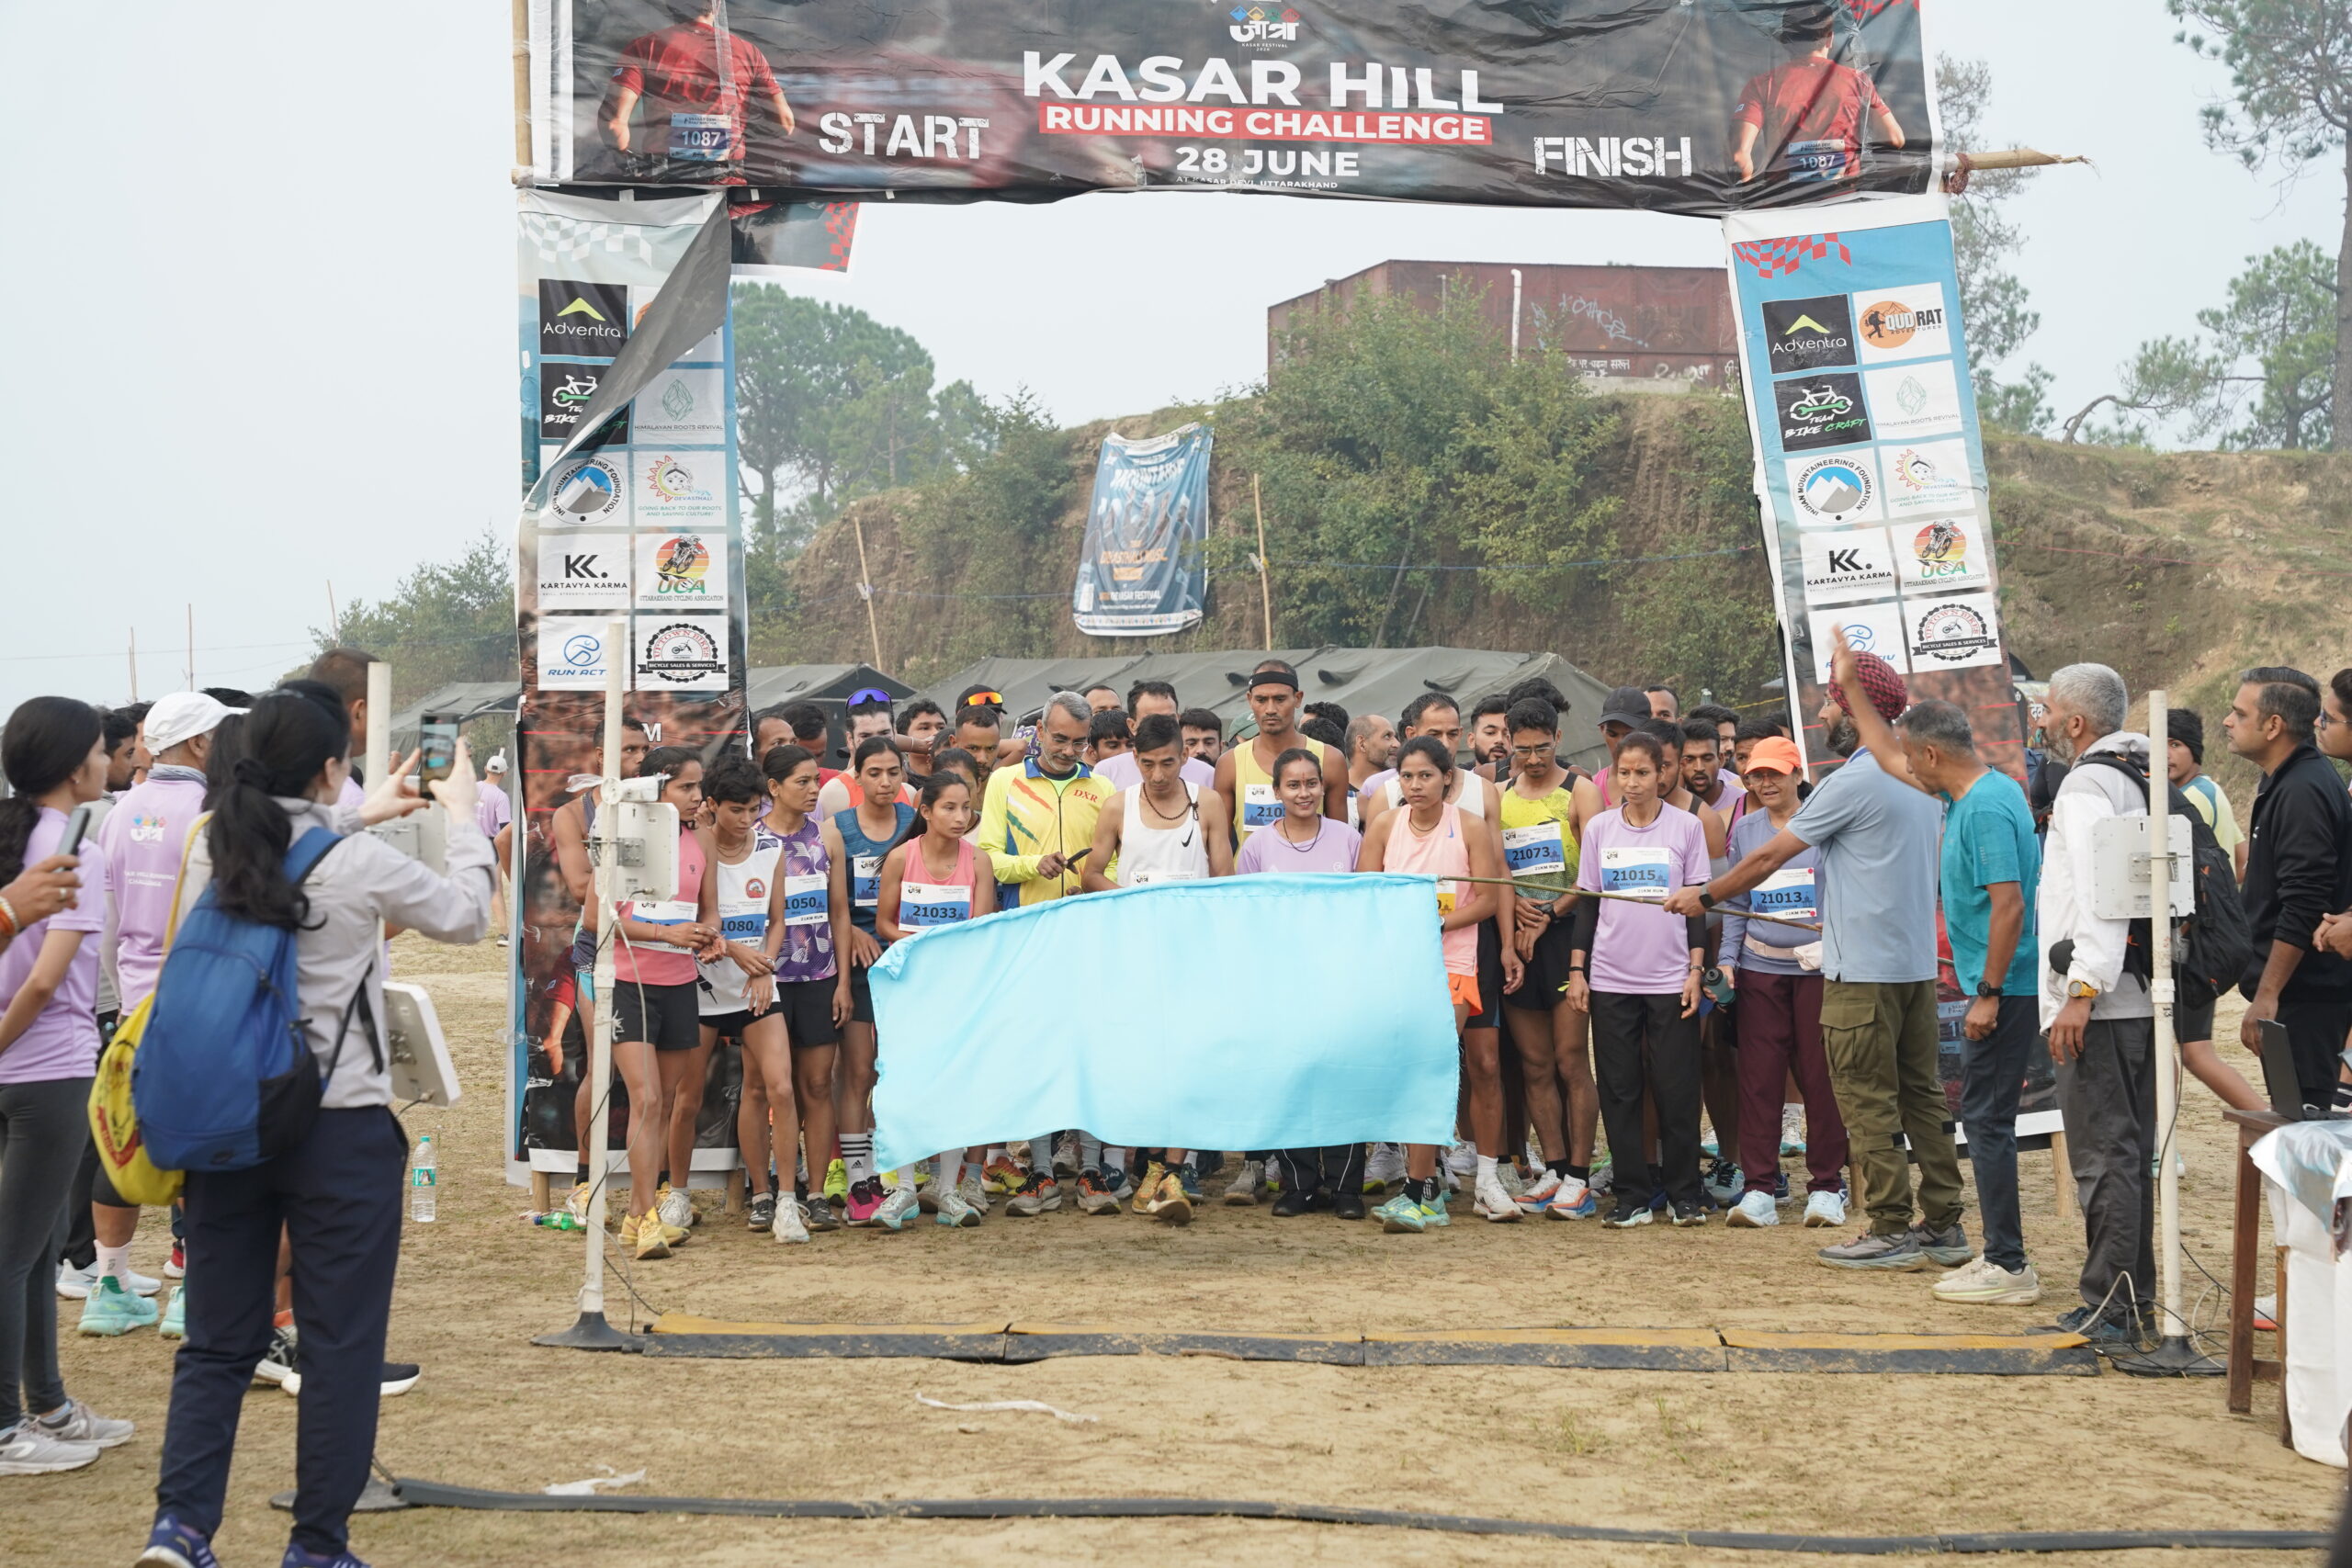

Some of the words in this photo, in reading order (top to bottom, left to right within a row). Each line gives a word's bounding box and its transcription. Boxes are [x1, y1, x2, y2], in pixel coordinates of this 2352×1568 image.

[1023, 51, 1301, 106] KASAR
[1329, 62, 1504, 114] HILL
[1046, 107, 1234, 134] RUNNING
[1246, 111, 1486, 141] CHALLENGE
[682, 130, 721, 147] 1087
[819, 112, 989, 159] START
[1175, 147, 1227, 174] 28
[1242, 150, 1360, 177] JUNE
[1533, 136, 1692, 177] FINISH
[1799, 154, 1836, 169] 1087
[1176, 175, 1188, 184] AT
[1260, 181, 1339, 189] UTTARAKHAND
[543, 321, 621, 338] Adventra
[1890, 324, 1942, 335] ADVENTURES
[1771, 337, 1848, 355] Adventra
[544, 413, 580, 424] BIKE
[1809, 413, 1835, 424] TEAM
[1933, 413, 1960, 422] REVIVAL
[1783, 425, 1822, 440] BIKE
[1824, 419, 1867, 433] CRAFT
[1797, 458, 1855, 493] MOUNTAINEERING
[606, 468, 622, 514] FOUNDATION
[1854, 466, 1871, 511] FOUNDATION
[1798, 495, 1819, 516] INDIAN
[1921, 560, 1967, 579] UCA
[657, 579, 706, 594] UCA
[1806, 575, 1856, 586] KARTAVYA
[1859, 571, 1893, 581] KARMA
[1904, 579, 1938, 588] UTTARAKHAND
[1957, 573, 1986, 582] ASSOCIATION
[1925, 609, 1959, 638] UPTOWN
[1960, 610, 1981, 635] BIKES
[653, 630, 691, 659] UPTOWN
[692, 632, 709, 659] BIKES
[1922, 642, 1942, 650] BICYCLE
[1962, 637, 1986, 646] SERVICES
[1073, 789, 1098, 803] DXR
[1512, 846, 1551, 861] 21073
[1612, 869, 1657, 882] 21015
[1760, 891, 1803, 904] 21013
[912, 905, 957, 919] 21033
